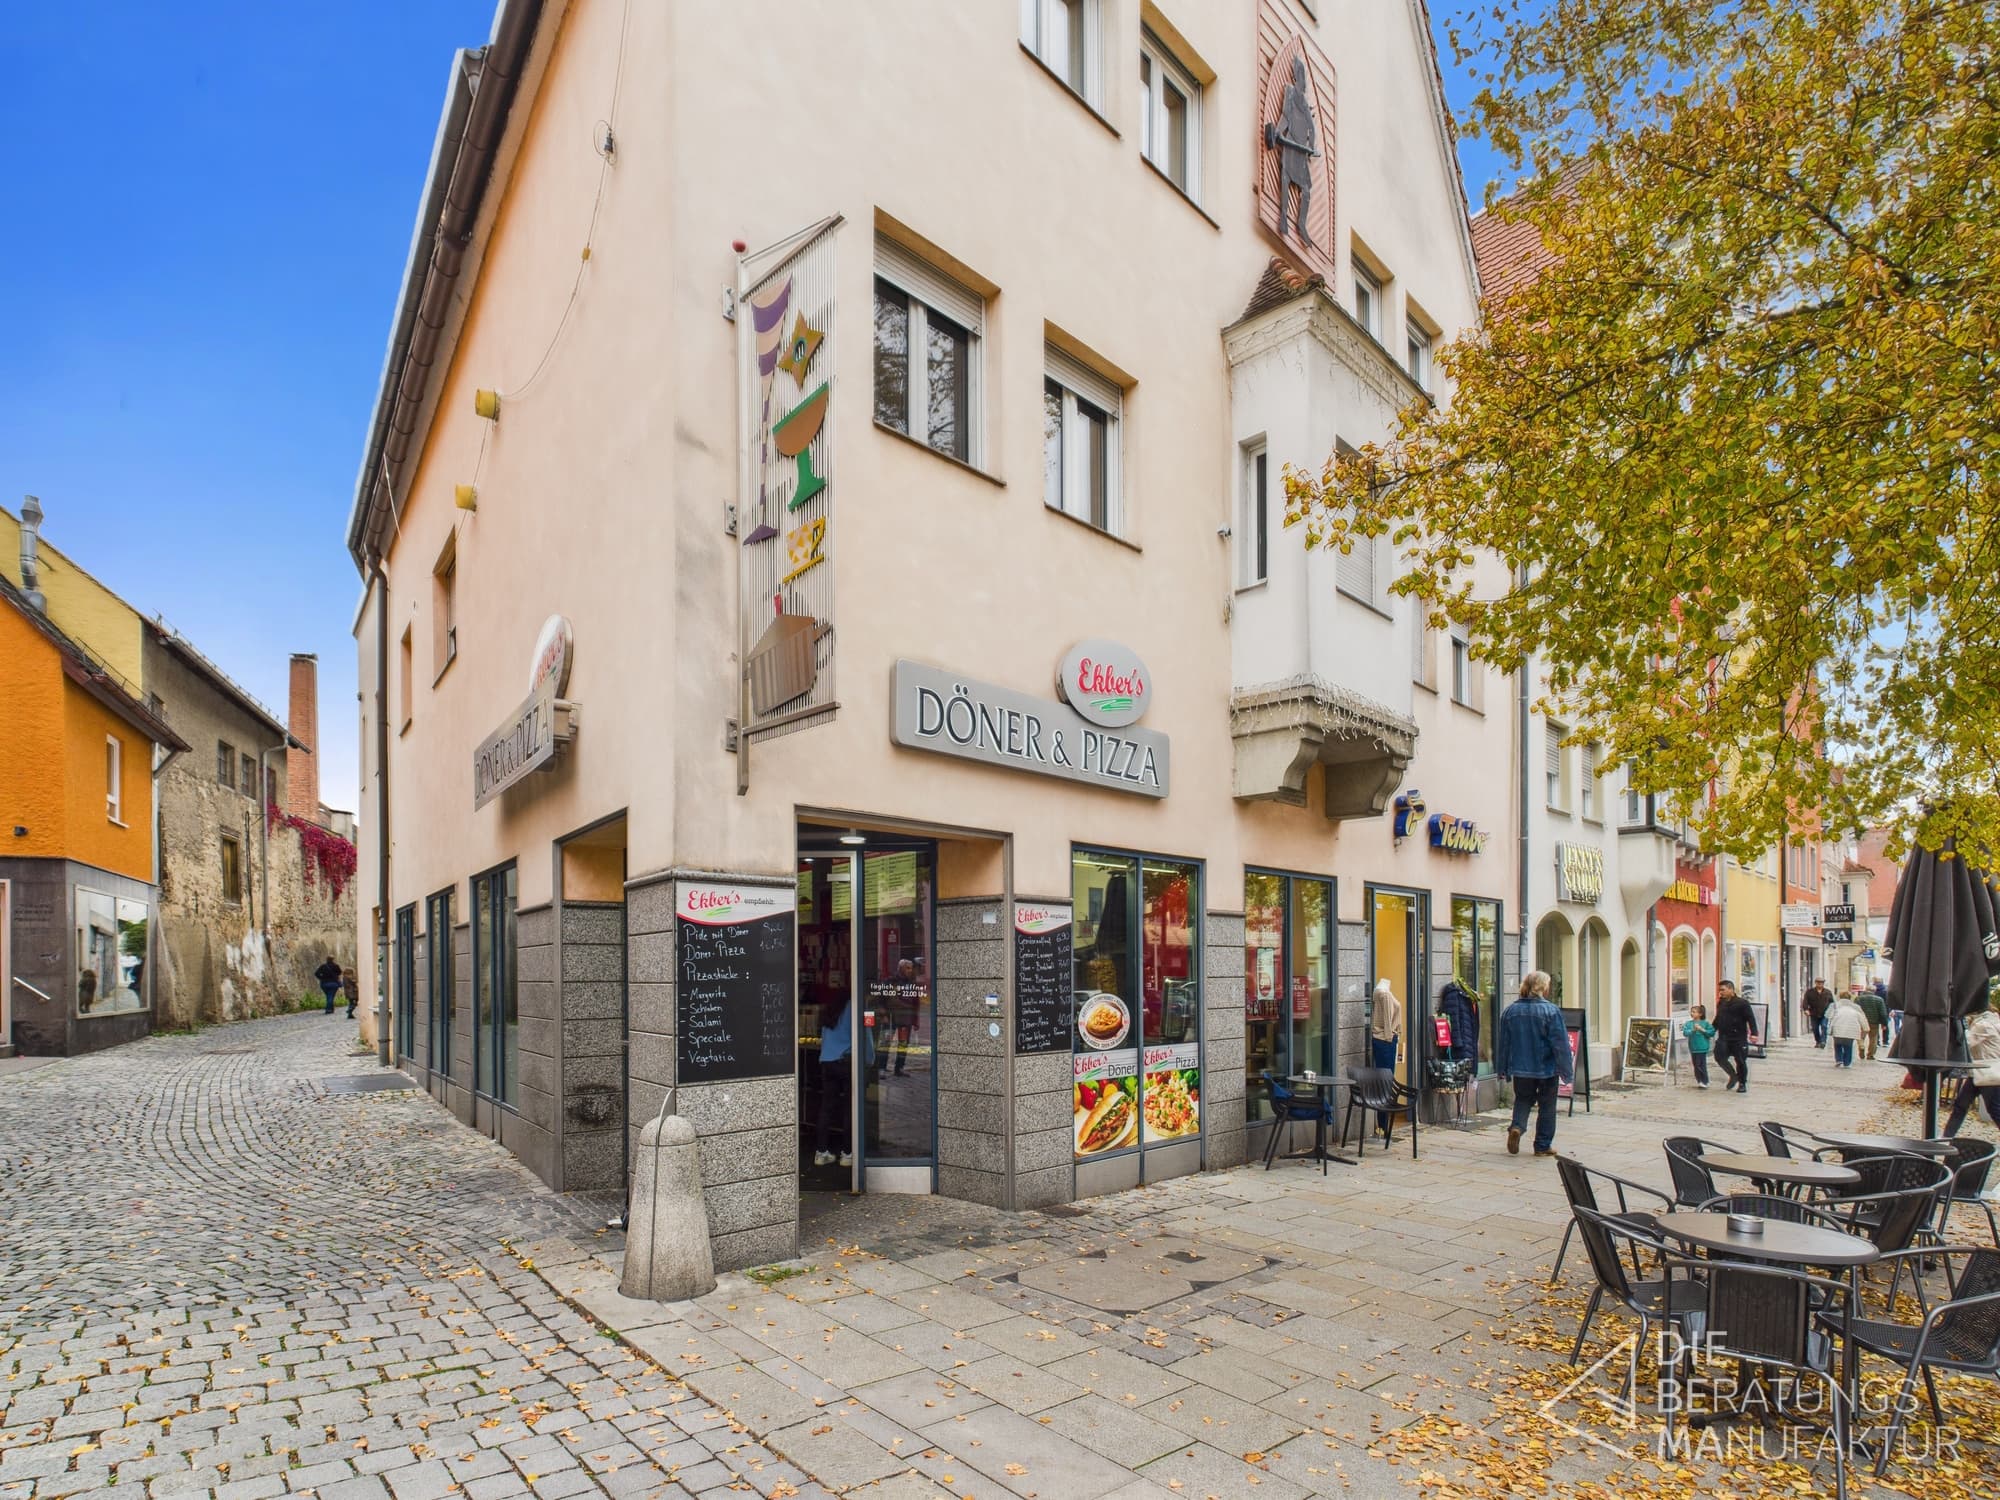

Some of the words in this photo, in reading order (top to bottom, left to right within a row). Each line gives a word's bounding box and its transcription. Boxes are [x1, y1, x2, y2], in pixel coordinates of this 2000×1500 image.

[1078, 657, 1144, 696] Ekber's
[516, 698, 551, 768] PIZZA
[915, 683, 1045, 763] DÖNER
[1052, 730, 1073, 768] &
[1080, 728, 1161, 788] PIZZA
[1439, 814, 1489, 854] Tchibo
[687, 890, 741, 910] Ekber's
[1825, 906, 1852, 914] MATT
[1018, 908, 1049, 923] Ekber's
[683, 924, 708, 943] Pide
[712, 929, 723, 939] mit
[689, 1014, 721, 1028] Salami
[689, 1029, 732, 1049] Speciale
[1074, 1053, 1109, 1076] Ekber's
[1108, 1063, 1137, 1078] Döner
[1143, 1047, 1173, 1068] Ekber's
[1175, 1056, 1197, 1069] Pizza
